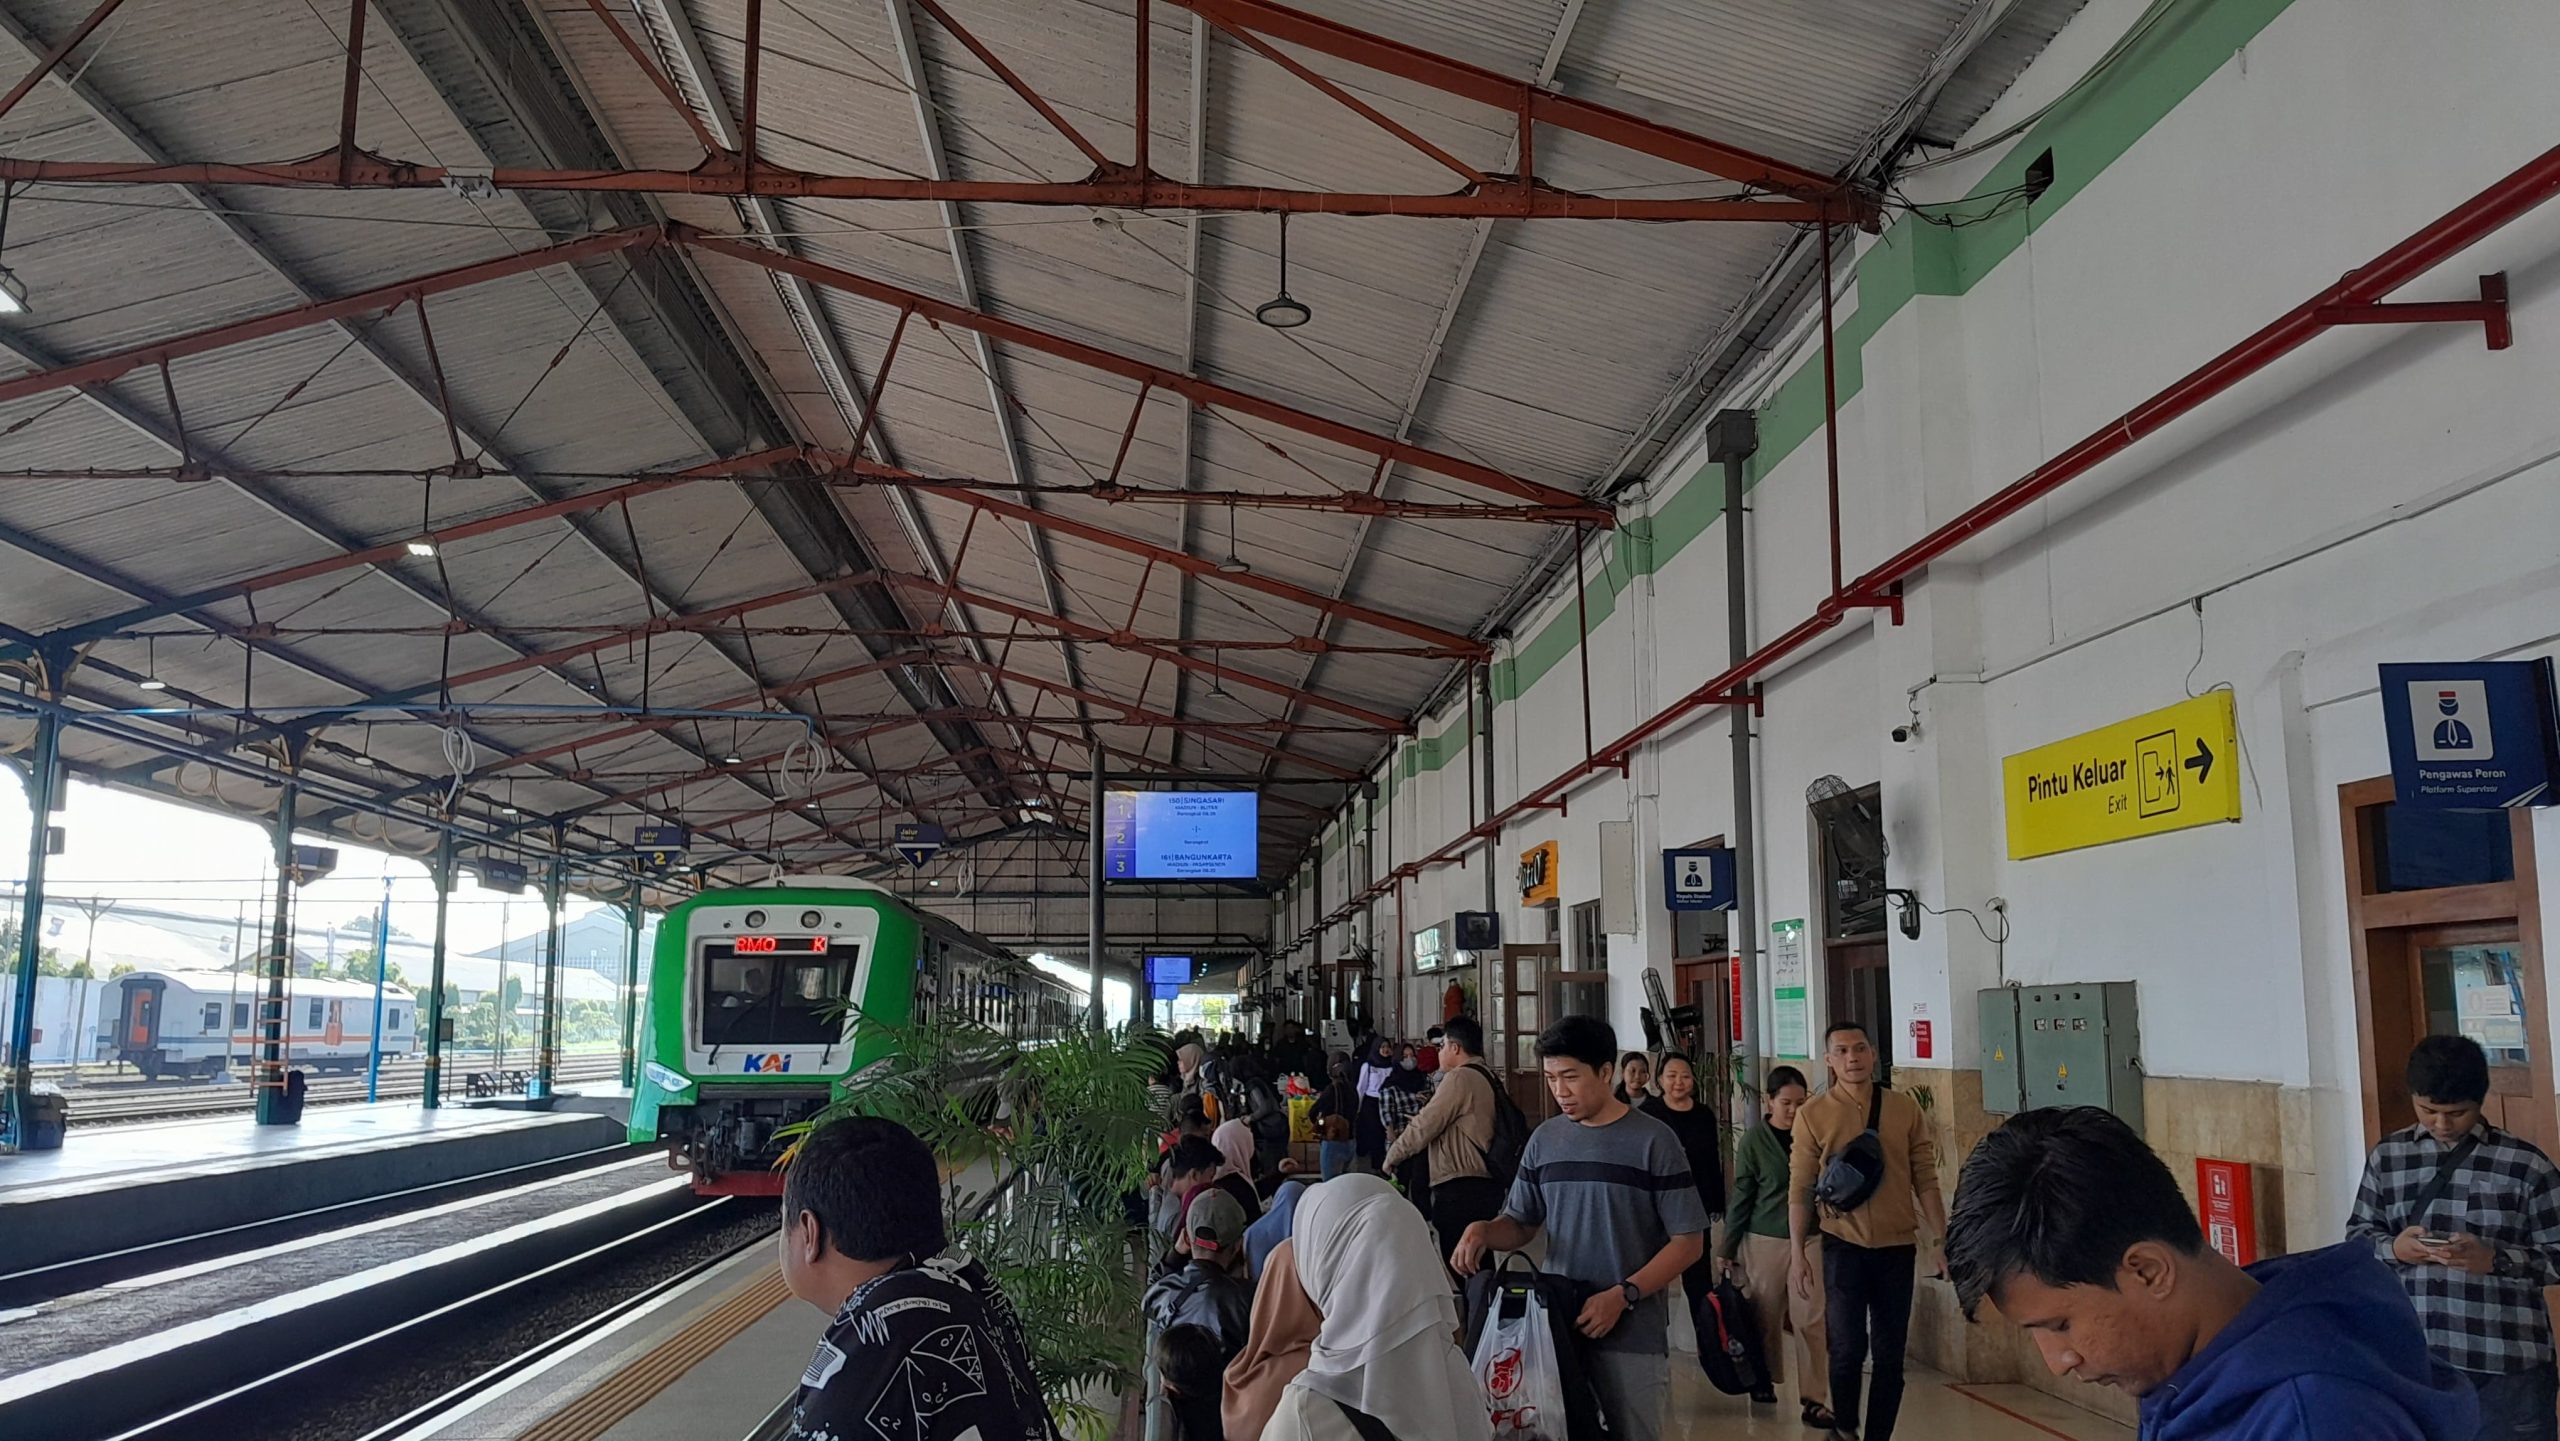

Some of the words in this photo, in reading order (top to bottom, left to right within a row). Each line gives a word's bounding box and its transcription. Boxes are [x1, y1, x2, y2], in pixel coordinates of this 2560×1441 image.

[2028, 773, 2068, 802] Pintu
[2073, 758, 2126, 791] Keluar
[2419, 769, 2473, 781] Pengawas
[2475, 768, 2506, 778] Peron
[2421, 785, 2454, 793] Platform
[2108, 794, 2127, 814] Exit
[1117, 833, 1125, 844] 2
[653, 852, 666, 865] 2
[914, 851, 921, 863] 1
[1116, 861, 1125, 872] 3
